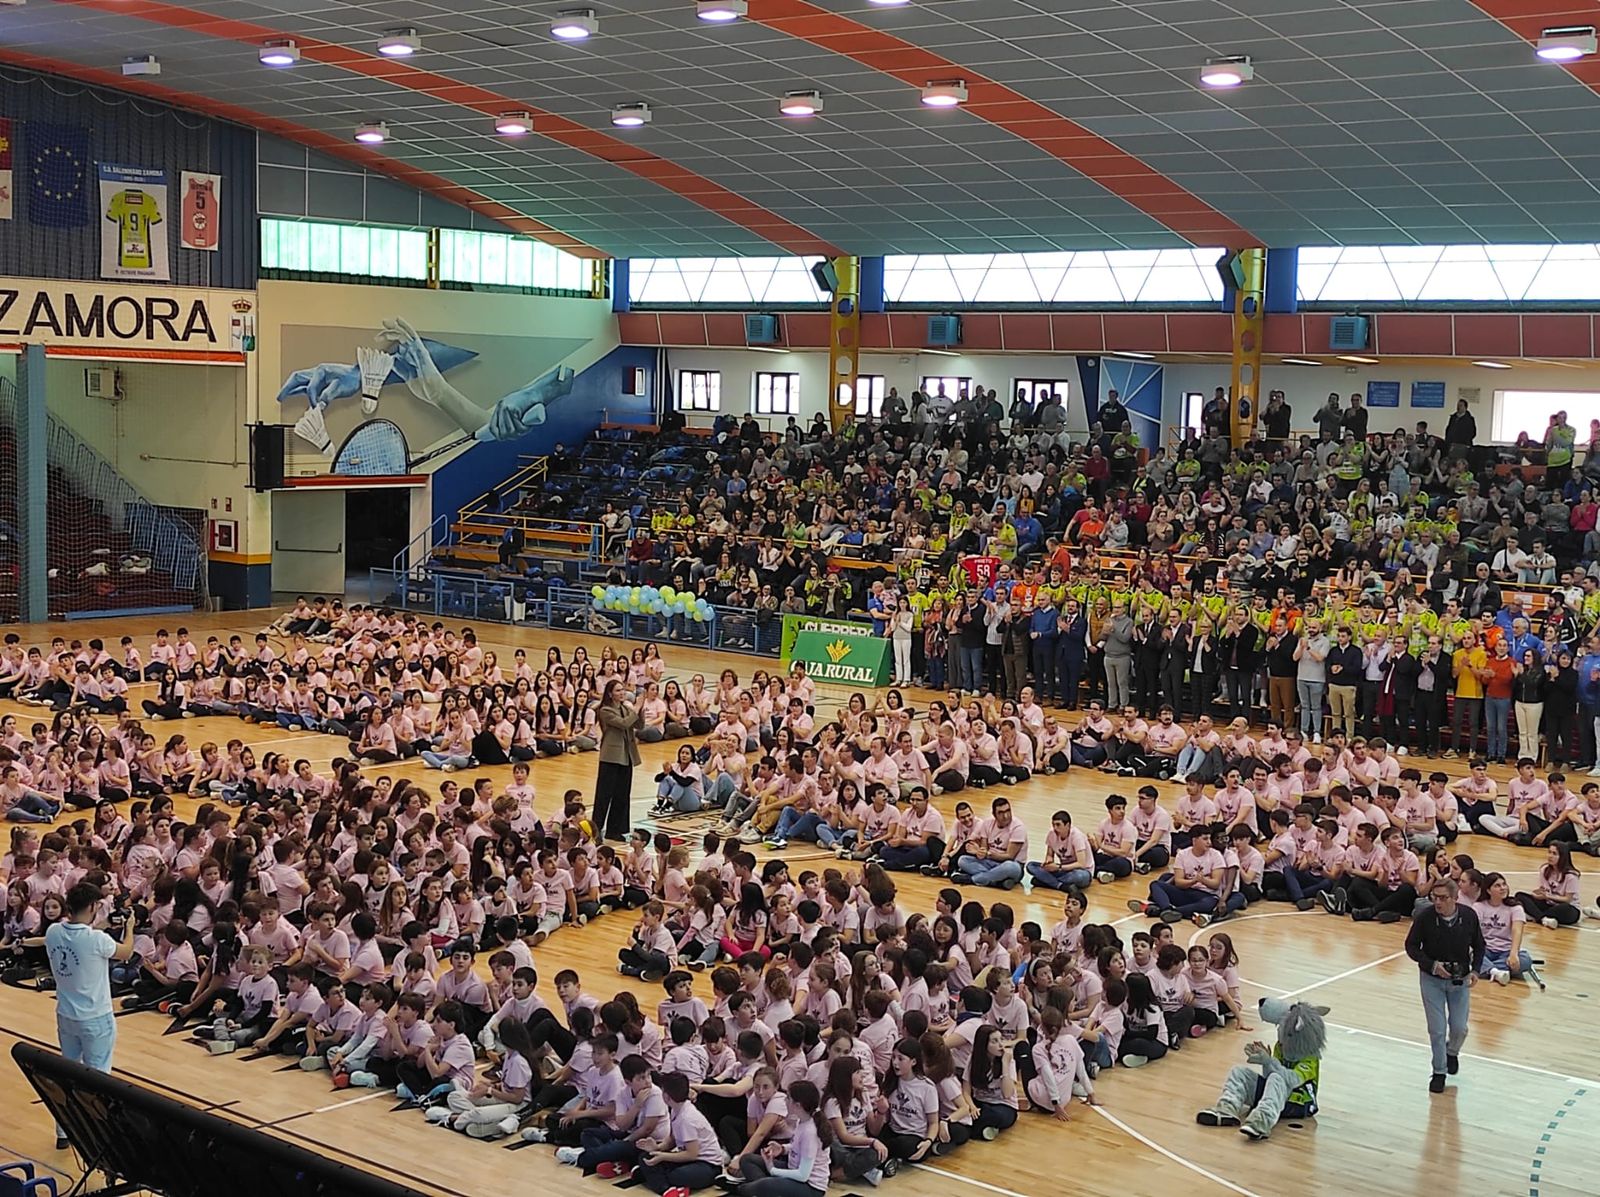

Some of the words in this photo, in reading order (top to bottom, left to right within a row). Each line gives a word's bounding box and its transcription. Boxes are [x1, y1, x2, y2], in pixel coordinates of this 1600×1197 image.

[195, 192, 206, 210] 5
[130, 213, 139, 231] 9
[0, 289, 217, 343] ZAMORA
[976, 564, 990, 578] 58
[824, 663, 874, 682] RURAL
